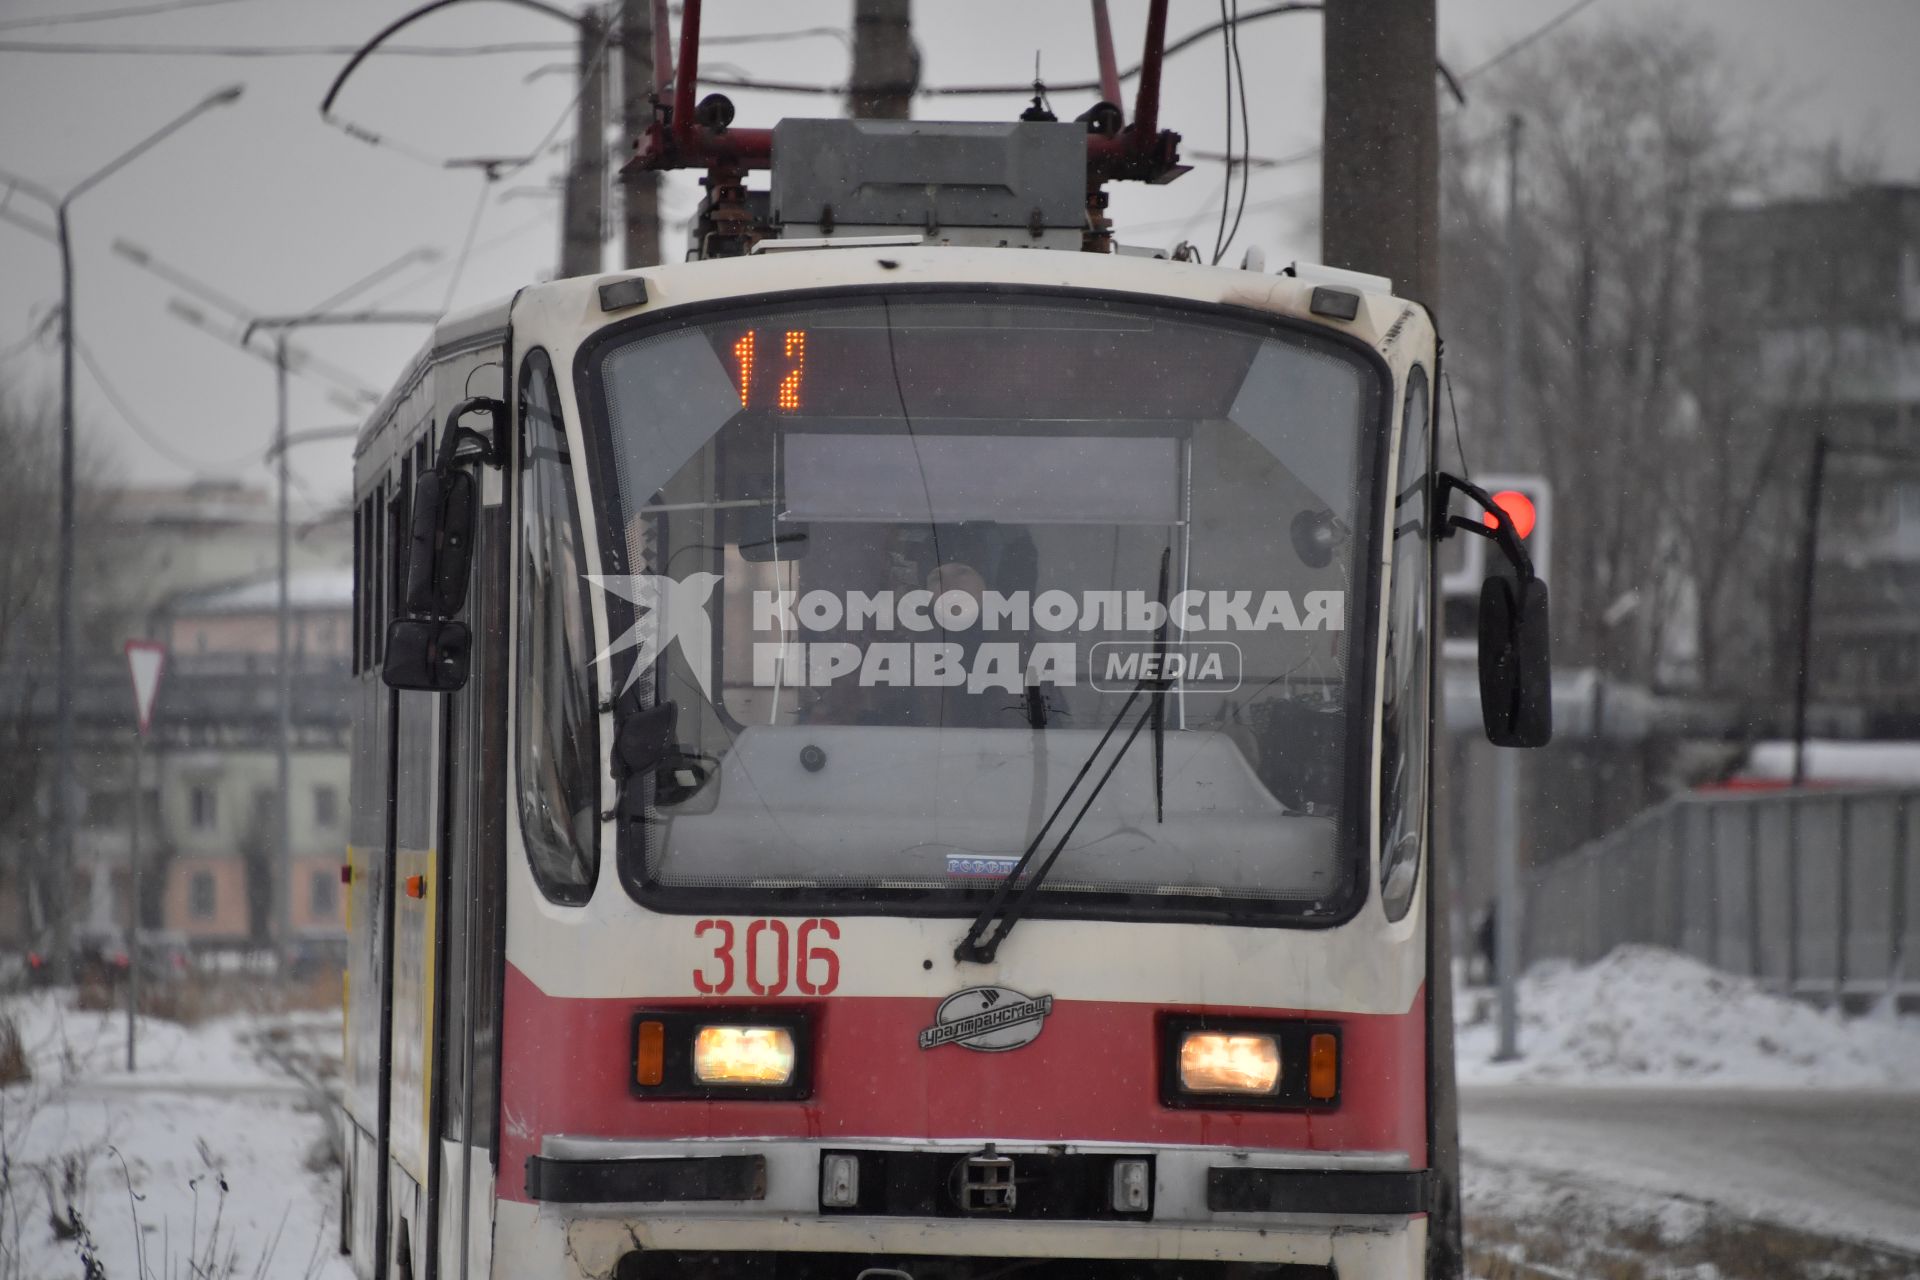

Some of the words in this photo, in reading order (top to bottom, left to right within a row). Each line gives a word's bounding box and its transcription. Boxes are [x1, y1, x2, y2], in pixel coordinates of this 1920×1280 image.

[735, 329, 805, 409] 12
[947, 859, 1027, 874] РОССИ
[693, 918, 841, 996] 306
